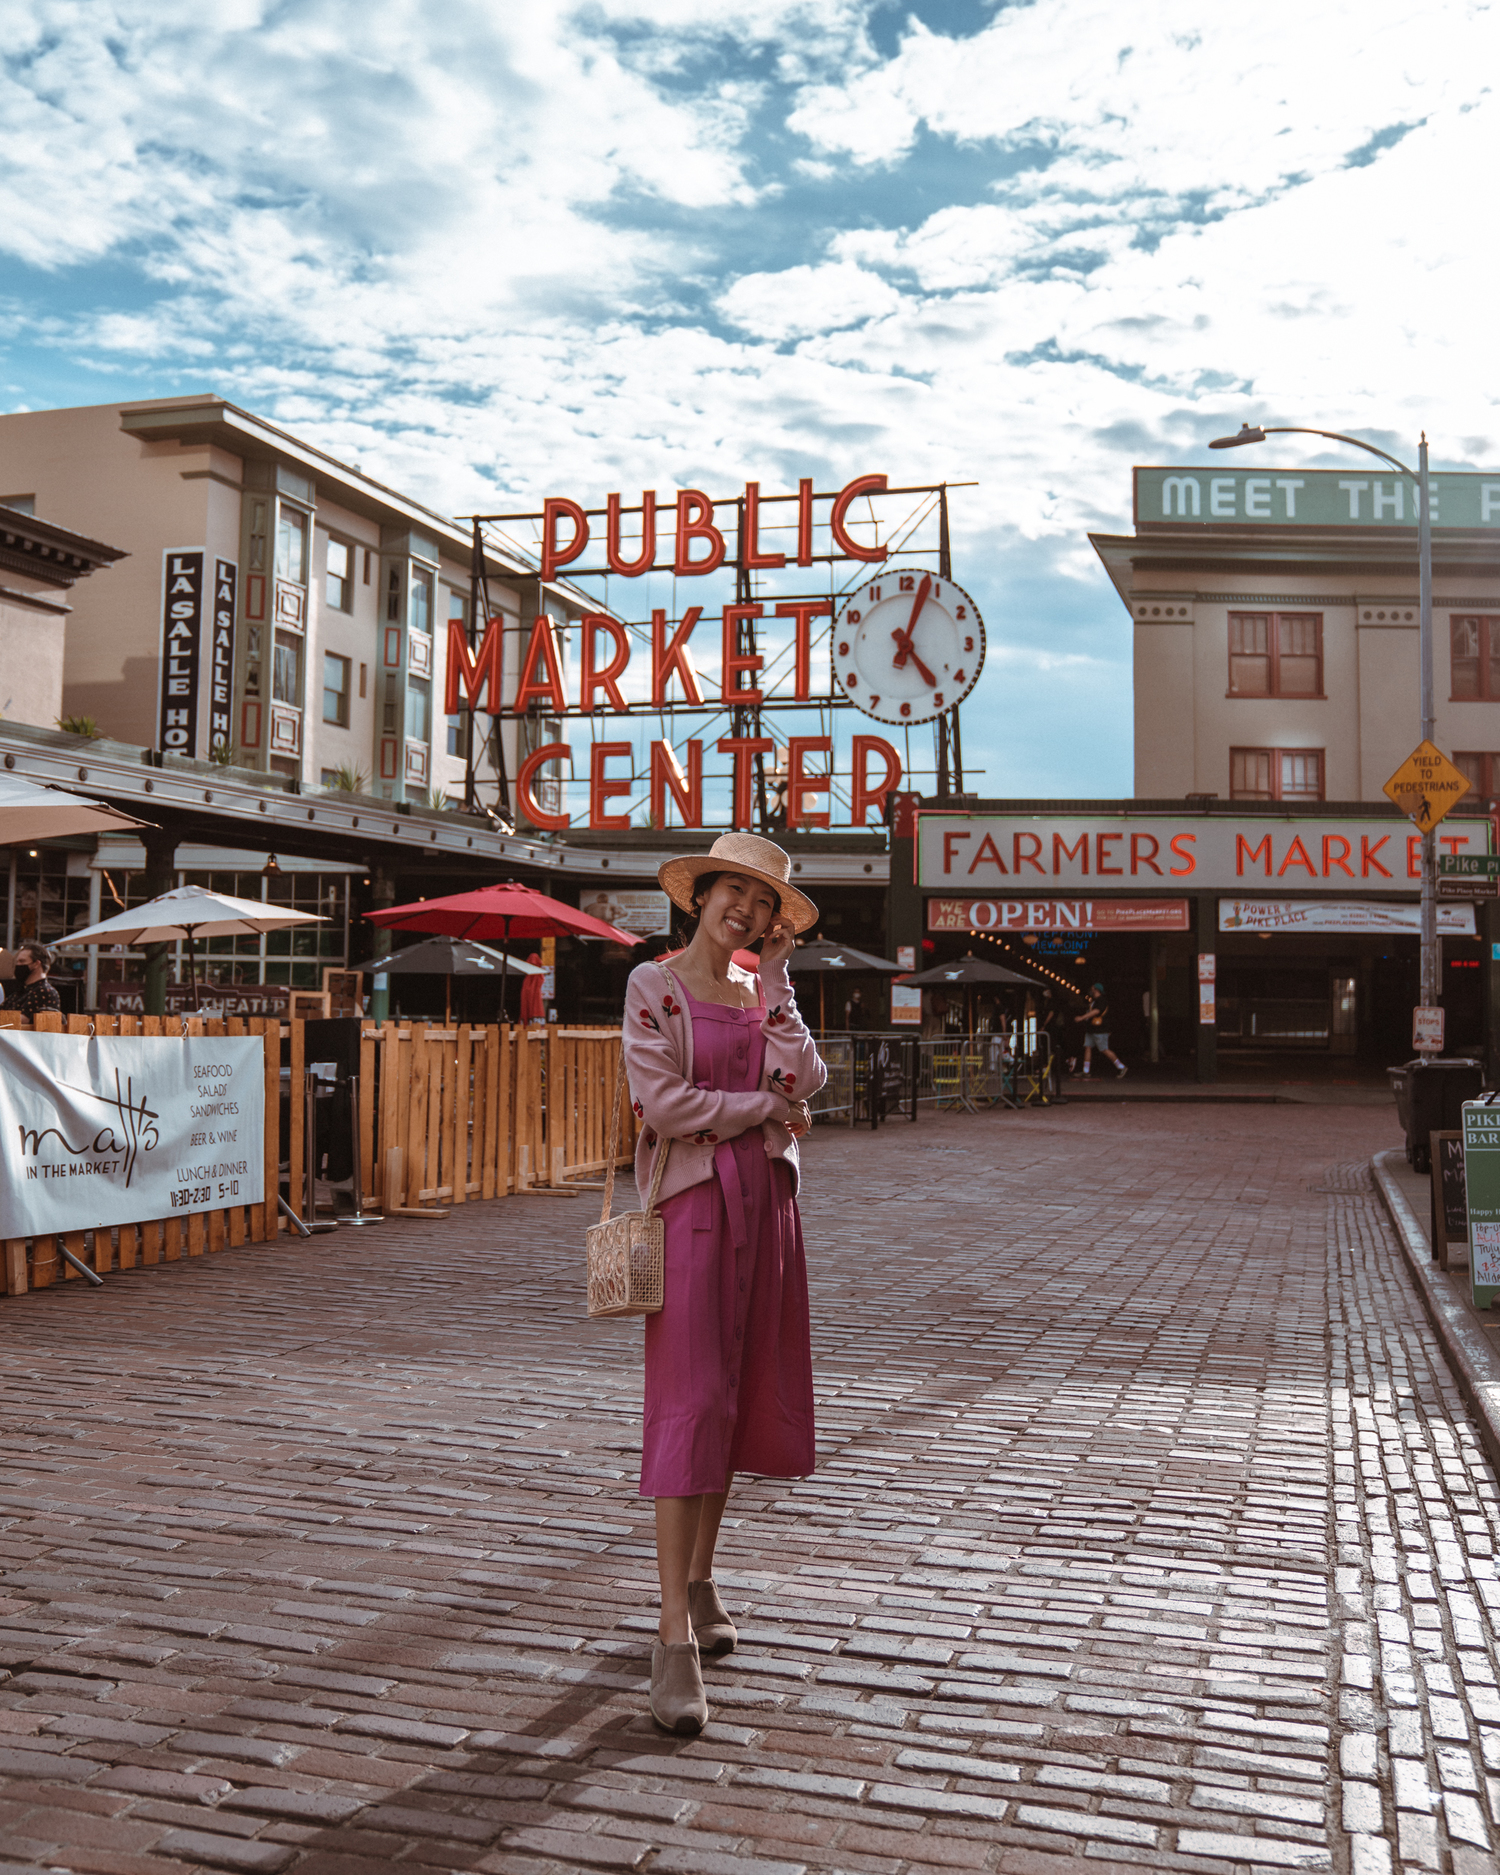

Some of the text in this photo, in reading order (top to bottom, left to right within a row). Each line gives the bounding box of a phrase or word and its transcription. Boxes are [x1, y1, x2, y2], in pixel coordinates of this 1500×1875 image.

[1162, 476, 1305, 518] MEET
[1338, 480, 1439, 521] THE
[541, 474, 888, 582] PUBLIC
[170, 558, 195, 594] LA
[217, 563, 232, 602] LA
[899, 576, 915, 591] 12
[869, 586, 881, 601] 11
[935, 583, 940, 598] 1
[847, 610, 861, 624] 10
[956, 605, 966, 620] 2
[168, 601, 195, 696] SALLE
[839, 642, 849, 656] 9
[964, 636, 974, 652] 3
[214, 610, 231, 703] SALLE
[444, 600, 833, 715] MARKET
[846, 673, 857, 688] 8
[953, 668, 966, 684] 4
[869, 695, 880, 710] 7
[934, 692, 944, 707] 5
[900, 703, 911, 717] 6
[1413, 756, 1441, 767] YIELD
[1420, 769, 1432, 779] TO
[516, 735, 902, 830] CENTER
[1394, 781, 1459, 793] PEDESTRIANS
[943, 832, 1469, 878] FARMERS MARKET
[1445, 856, 1499, 872] Pike Pl
[940, 902, 964, 914] WE
[969, 902, 1093, 928] OPEN!
[1243, 903, 1281, 915] POWER
[934, 914, 966, 927] ARE
[1246, 911, 1308, 927] PIKE PLACE
[193, 1064, 232, 1078] SEAFOOD
[198, 1083, 227, 1098] SALADS
[190, 1102, 239, 1118] SANDWICHES
[190, 1129, 238, 1146] BEER & WINE
[1467, 1132, 1499, 1144] BAR
[26, 1160, 120, 1179] IN THE MARKET
[177, 1160, 248, 1182] LUNCH & DINNER
[170, 1180, 239, 1207] 11:30-2:30 5-10
[1470, 1208, 1493, 1216] Happy
[1475, 1222, 1500, 1234] Pop-U
